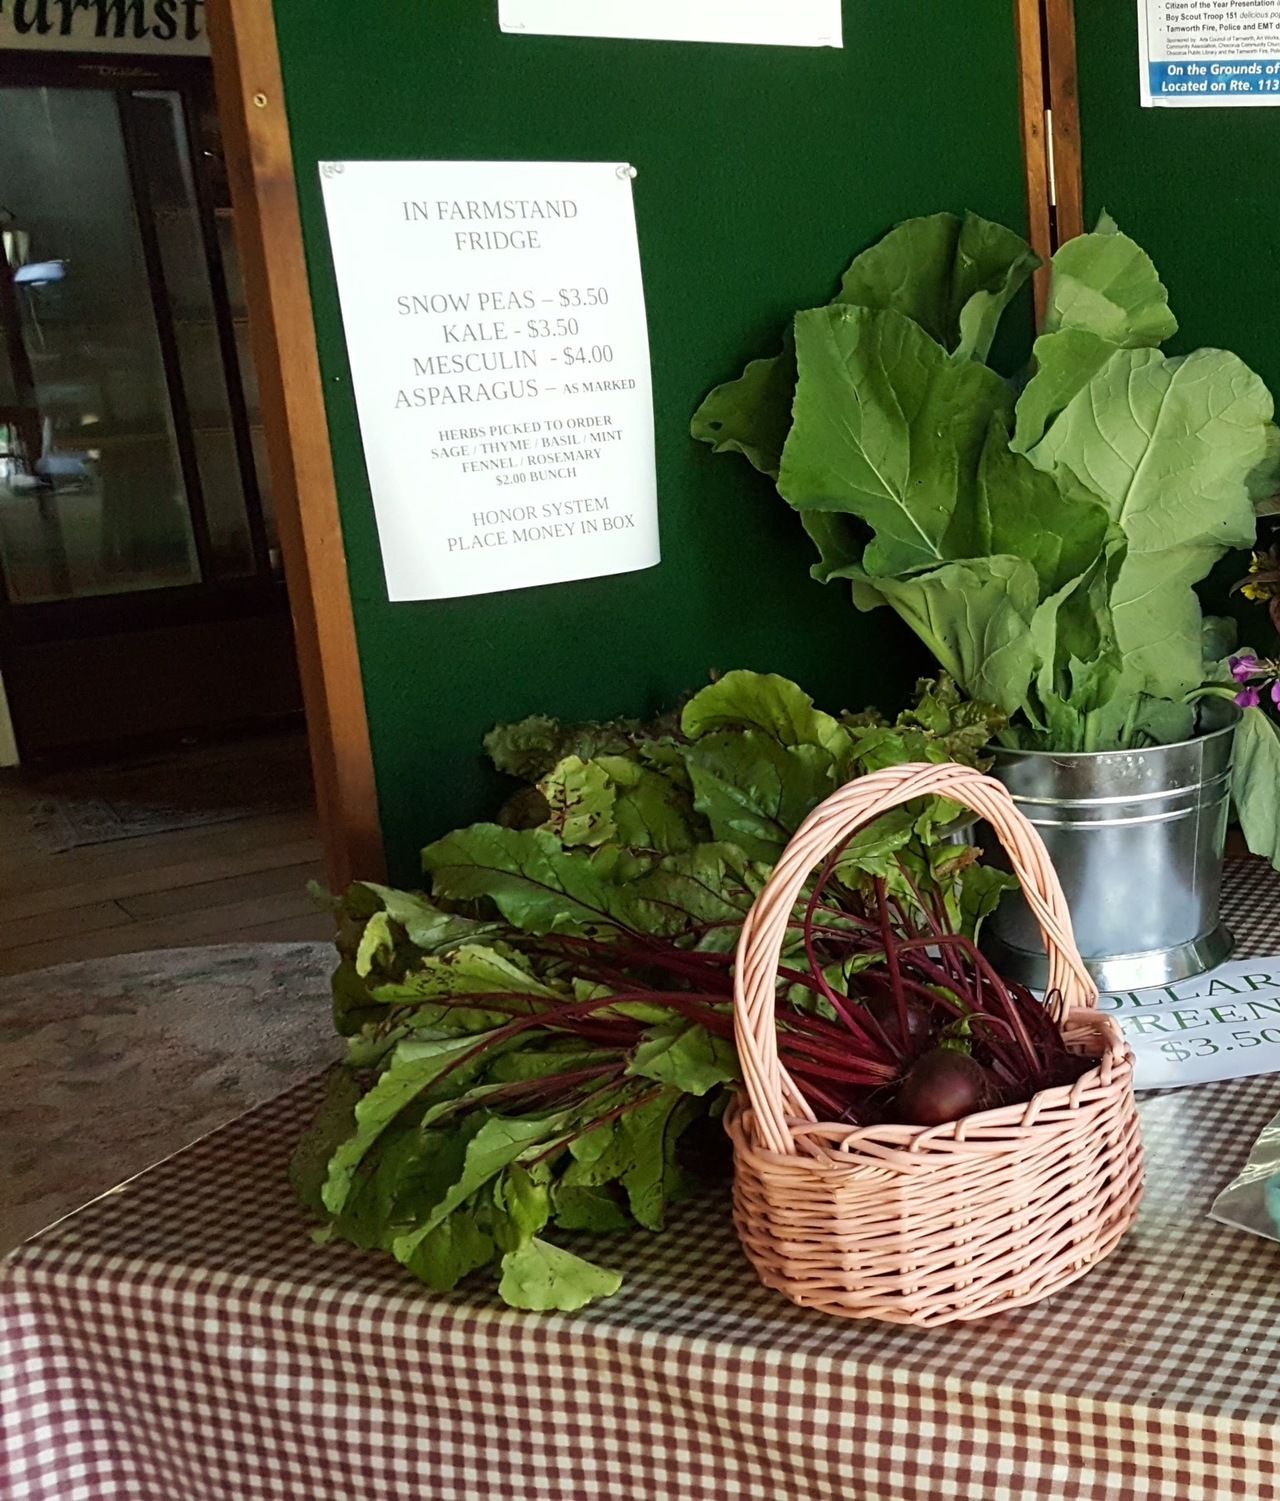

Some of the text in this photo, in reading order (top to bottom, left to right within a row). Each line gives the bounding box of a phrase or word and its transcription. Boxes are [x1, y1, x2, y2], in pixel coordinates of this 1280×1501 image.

[1166, 24, 1201, 33] Tamworth
[1219, 23, 1241, 31] Police
[1167, 63, 1184, 76] On
[1186, 62, 1207, 75] the
[1210, 62, 1262, 75] Grounds
[1161, 80, 1208, 92] Located
[1229, 80, 1253, 91] Rte.
[1258, 79, 1279, 91] 113
[402, 200, 578, 221] IN FARMSTAND
[455, 230, 542, 250] FRIDGE
[397, 287, 609, 315] SNOW PEAS $3.50
[443, 318, 579, 343] KALE $3.50
[413, 345, 614, 376] MESCULIN $4.00
[394, 378, 636, 408] ASPARAGUS MARKED
[438, 415, 613, 442] HERBS PICKED ORDER
[430, 430, 624, 460] SAGE THYME BASIL MINT
[461, 448, 602, 473] FENNEL ROSEMARY
[495, 467, 577, 486] $2.00 BUNCH
[472, 497, 610, 527] HONOR SYSTEM
[447, 514, 636, 552] PLACE MONEY IN BOX
